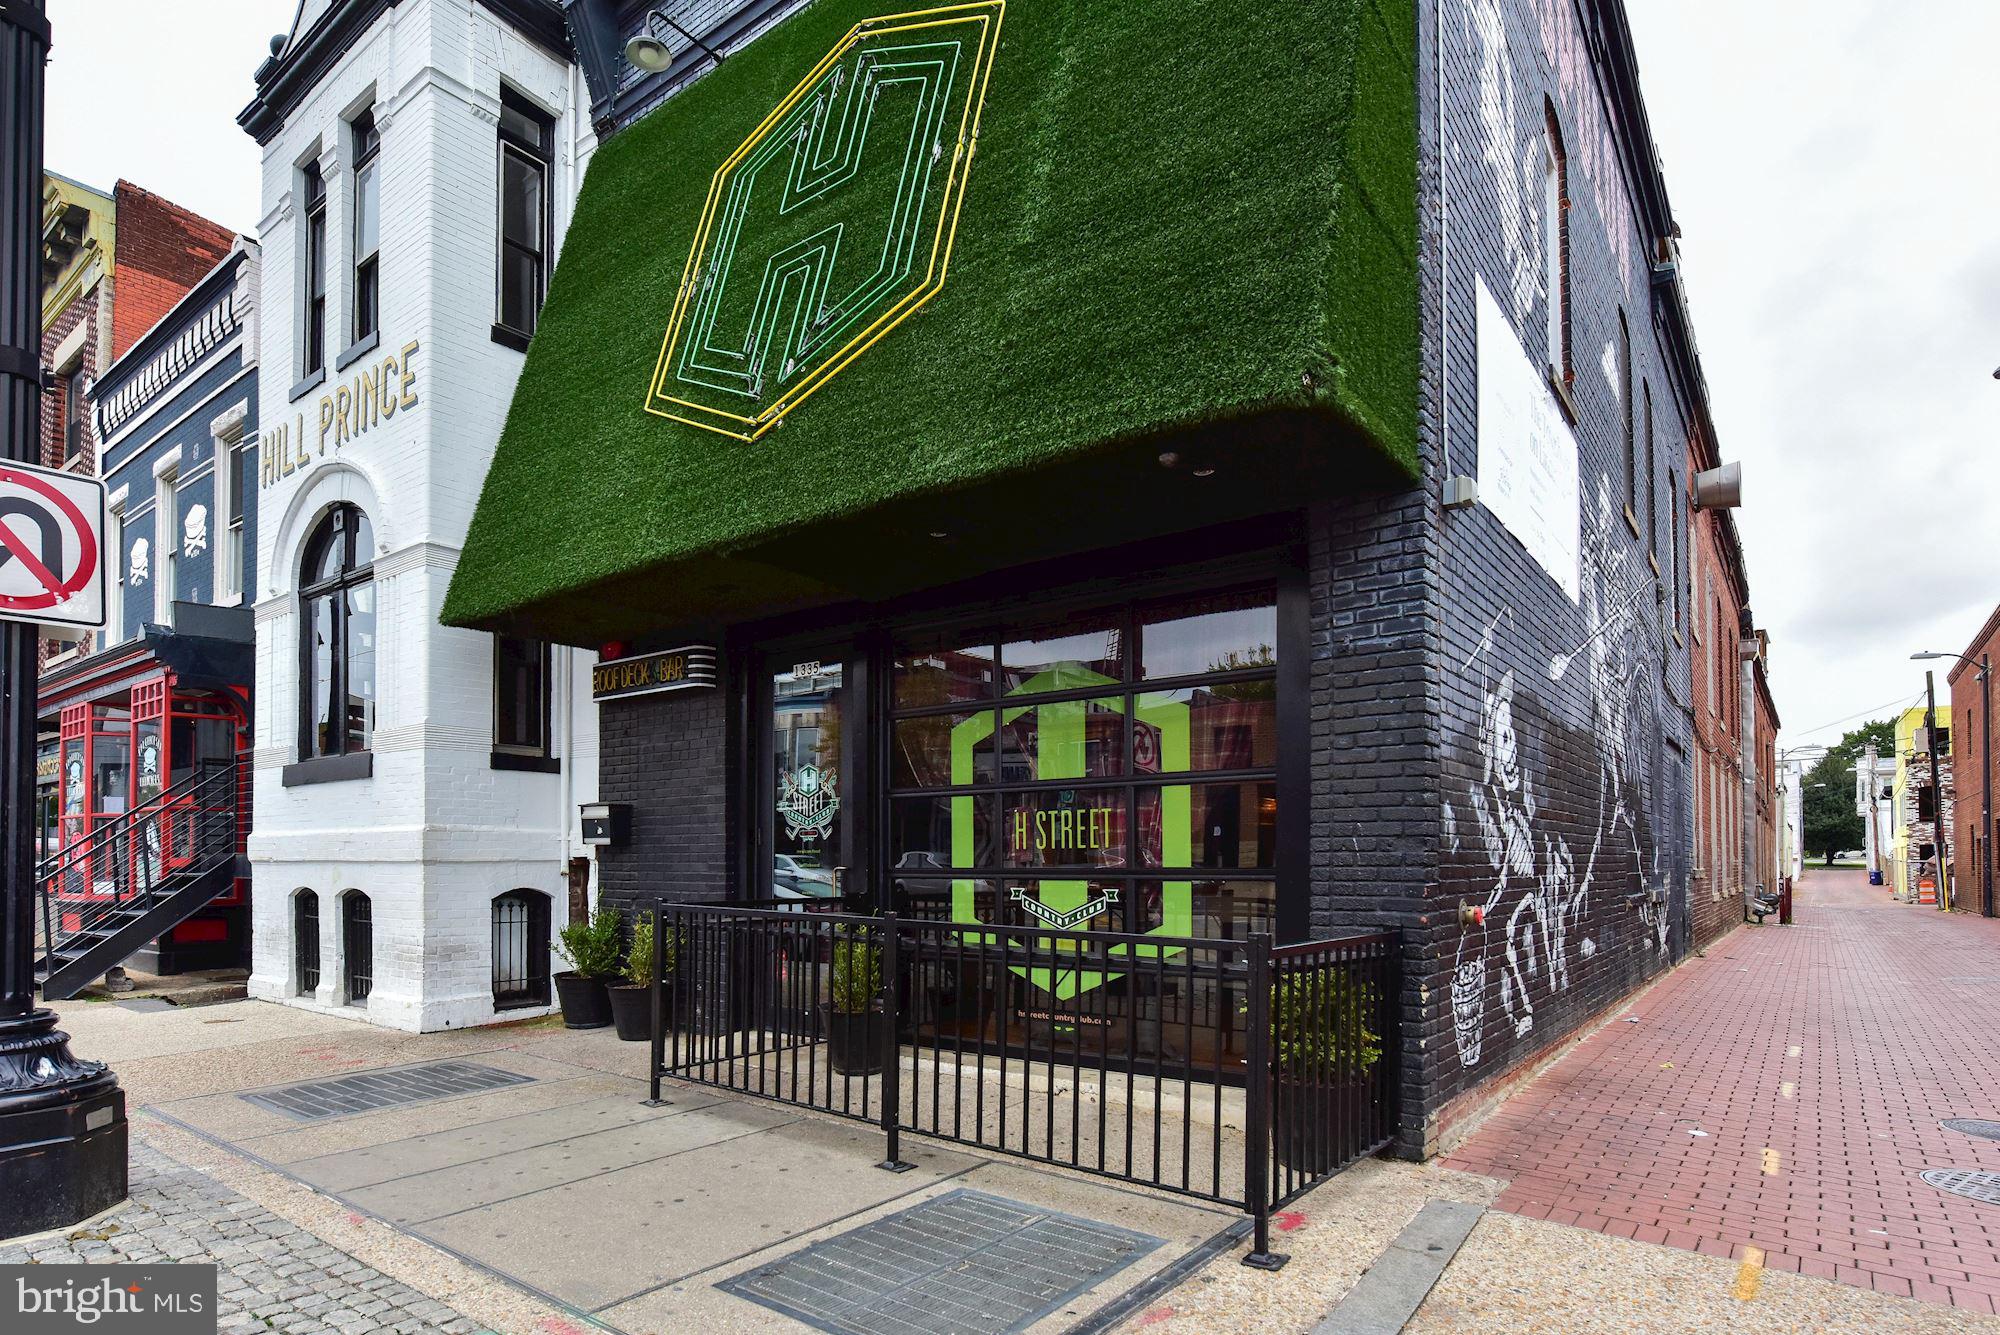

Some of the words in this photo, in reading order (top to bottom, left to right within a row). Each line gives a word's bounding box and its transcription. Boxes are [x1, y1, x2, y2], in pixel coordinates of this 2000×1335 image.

[260, 412, 310, 489] HILL
[319, 339, 419, 457] PRINCE
[660, 655, 684, 682] BAR
[794, 662, 819, 677] 1335
[792, 788, 824, 817] STREET
[1015, 811, 1027, 850] H
[1035, 808, 1112, 850] STREET
[1024, 899, 1070, 926] COUNTRY
[1075, 901, 1103, 920] CLUB
